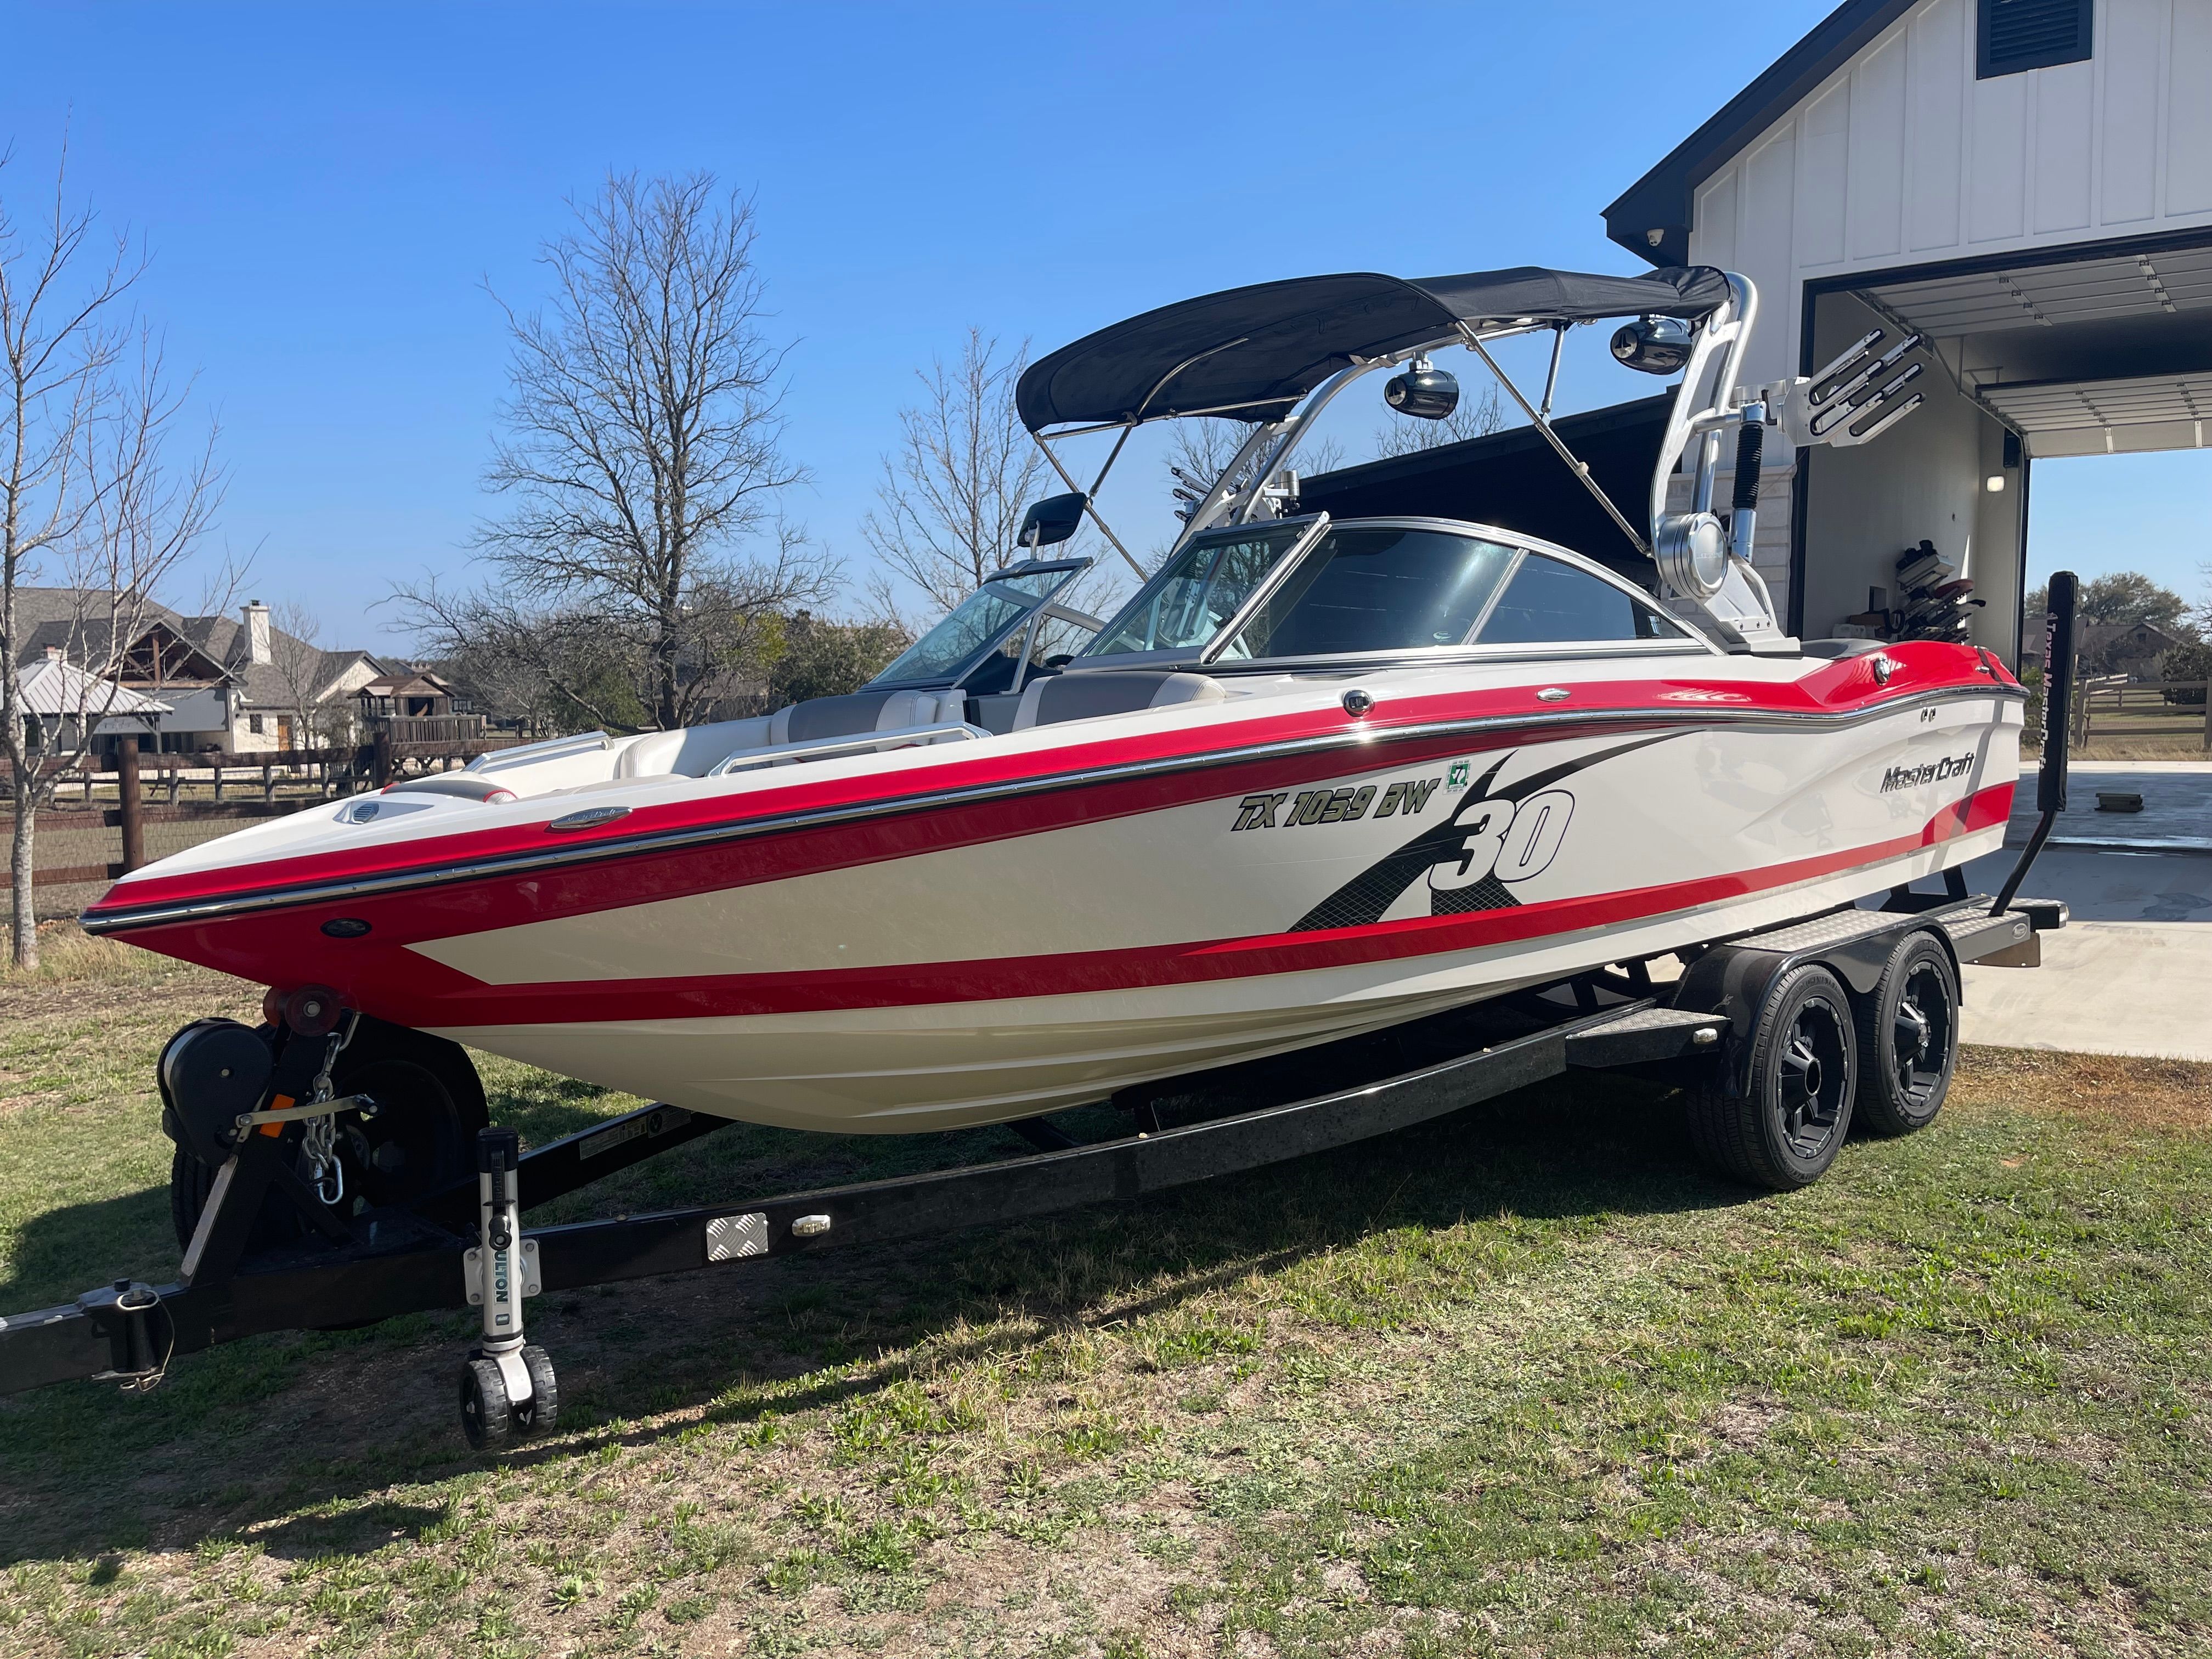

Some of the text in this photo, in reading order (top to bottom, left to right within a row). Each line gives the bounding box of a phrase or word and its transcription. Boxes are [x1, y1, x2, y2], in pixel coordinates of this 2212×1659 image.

[1880, 752, 1974, 794] MasterCraft
[1230, 777, 1442, 831] TX 1059 BW
[494, 1250, 509, 1303] ULTON
